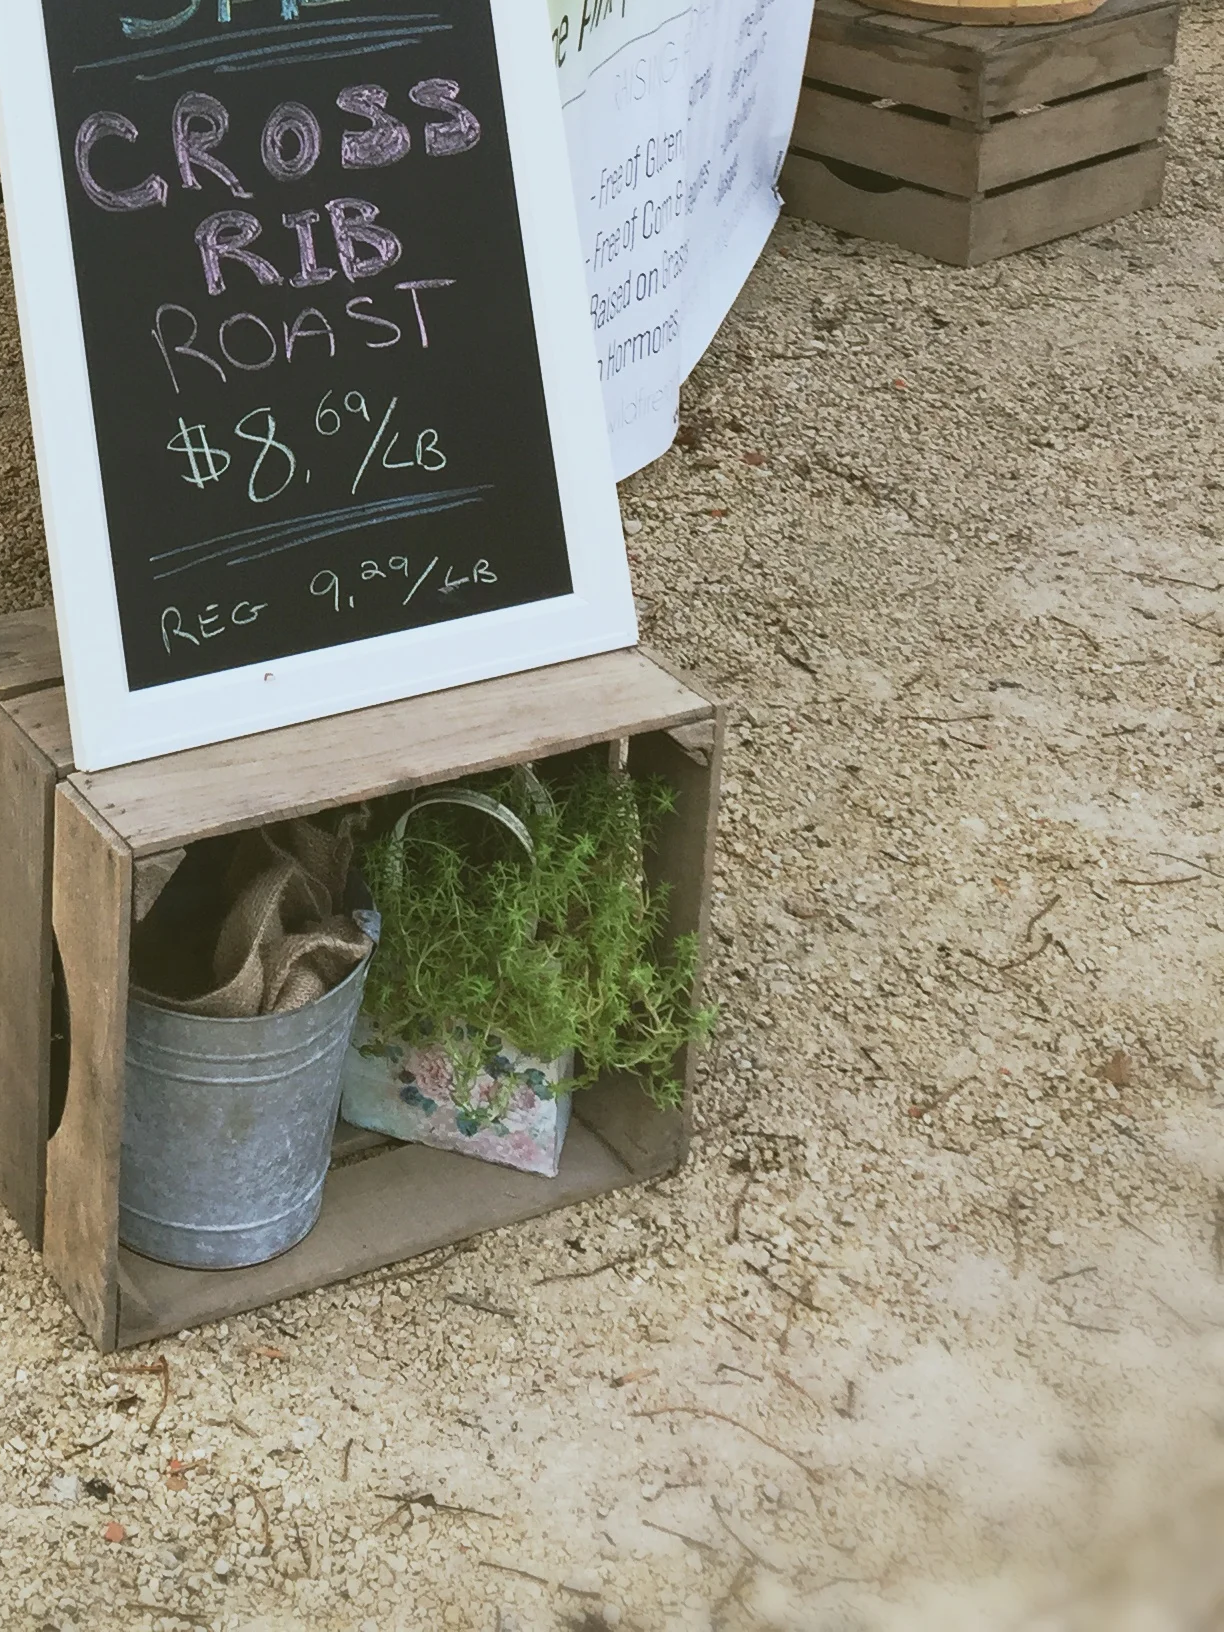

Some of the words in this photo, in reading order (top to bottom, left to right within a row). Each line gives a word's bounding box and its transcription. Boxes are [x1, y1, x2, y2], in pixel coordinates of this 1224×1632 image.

[75, 77, 480, 212] CROSS
[194, 197, 402, 296] RIB
[636, 267, 659, 302] on
[151, 279, 456, 394] ROAST
[160, 602, 268, 655] REG
